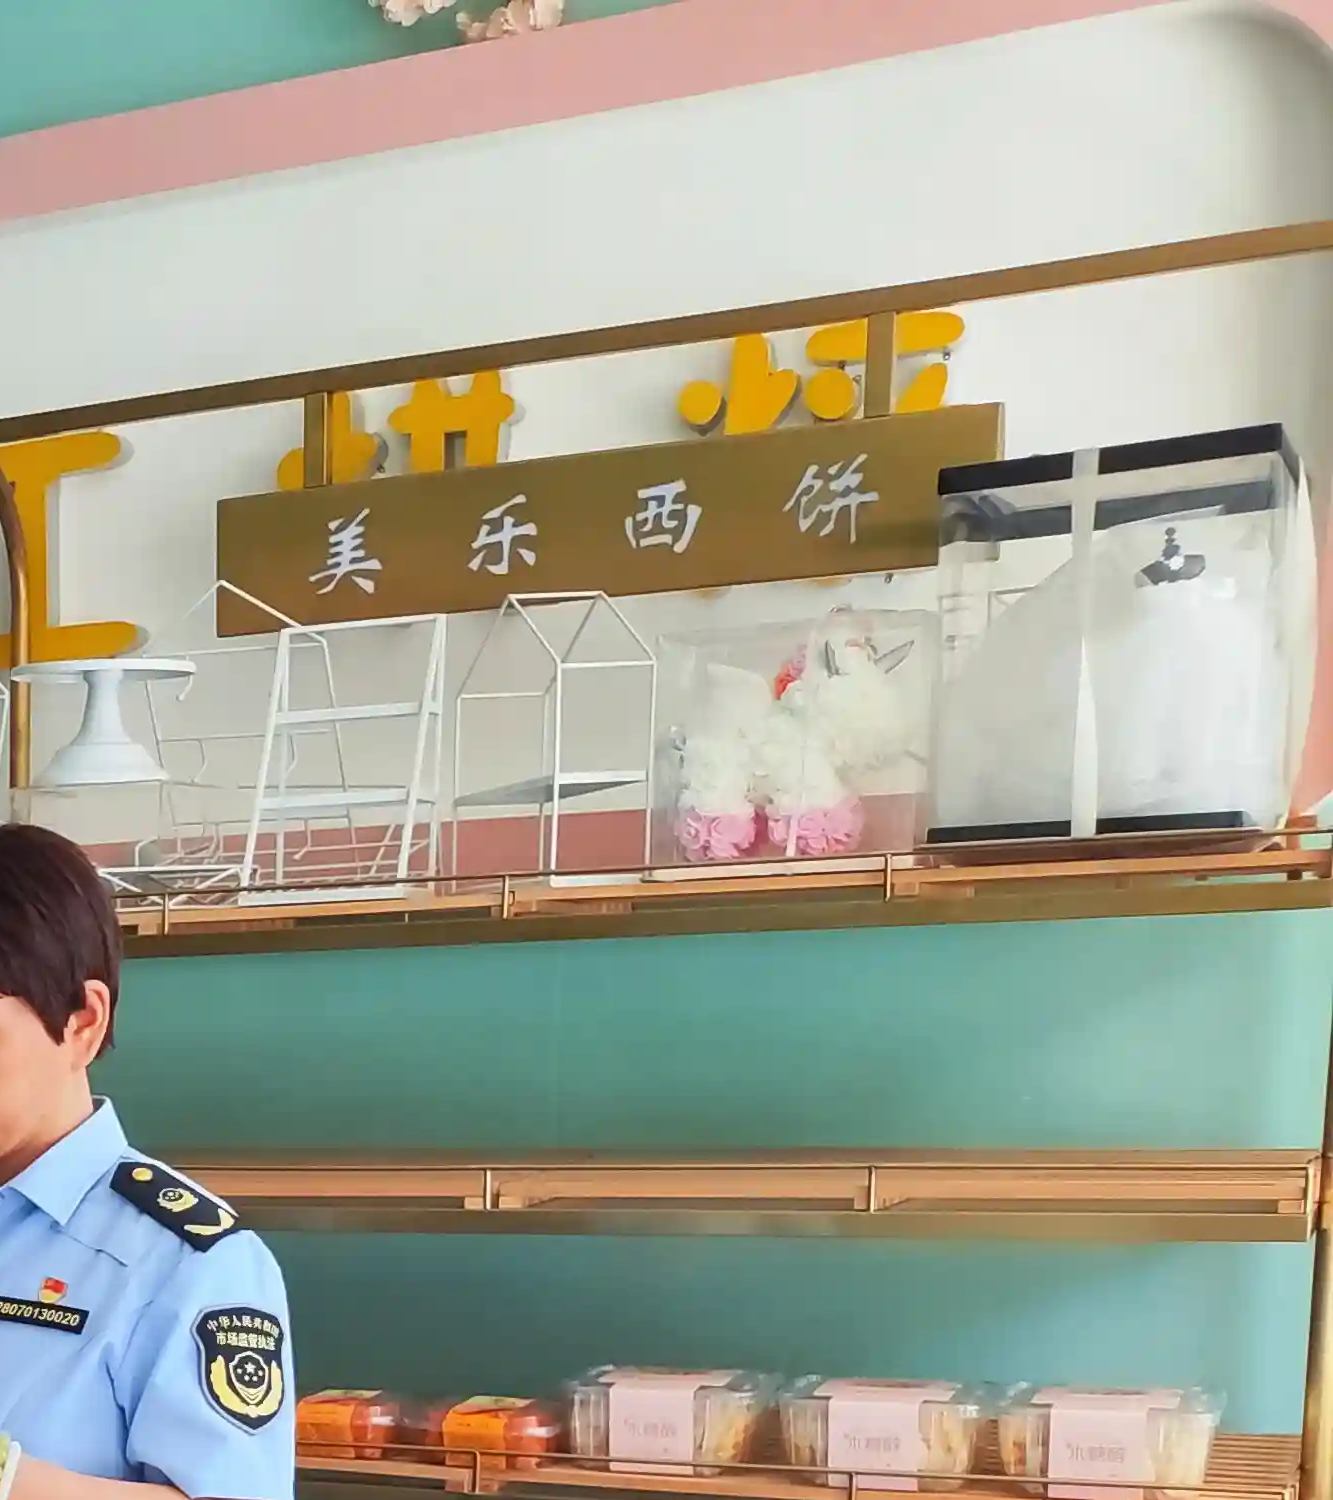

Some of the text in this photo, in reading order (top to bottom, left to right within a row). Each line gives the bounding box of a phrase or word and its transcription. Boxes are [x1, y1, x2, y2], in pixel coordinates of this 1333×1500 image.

[308, 453, 879, 596] 美乐西饼
[206, 1314, 280, 1338] 中华人民共和国
